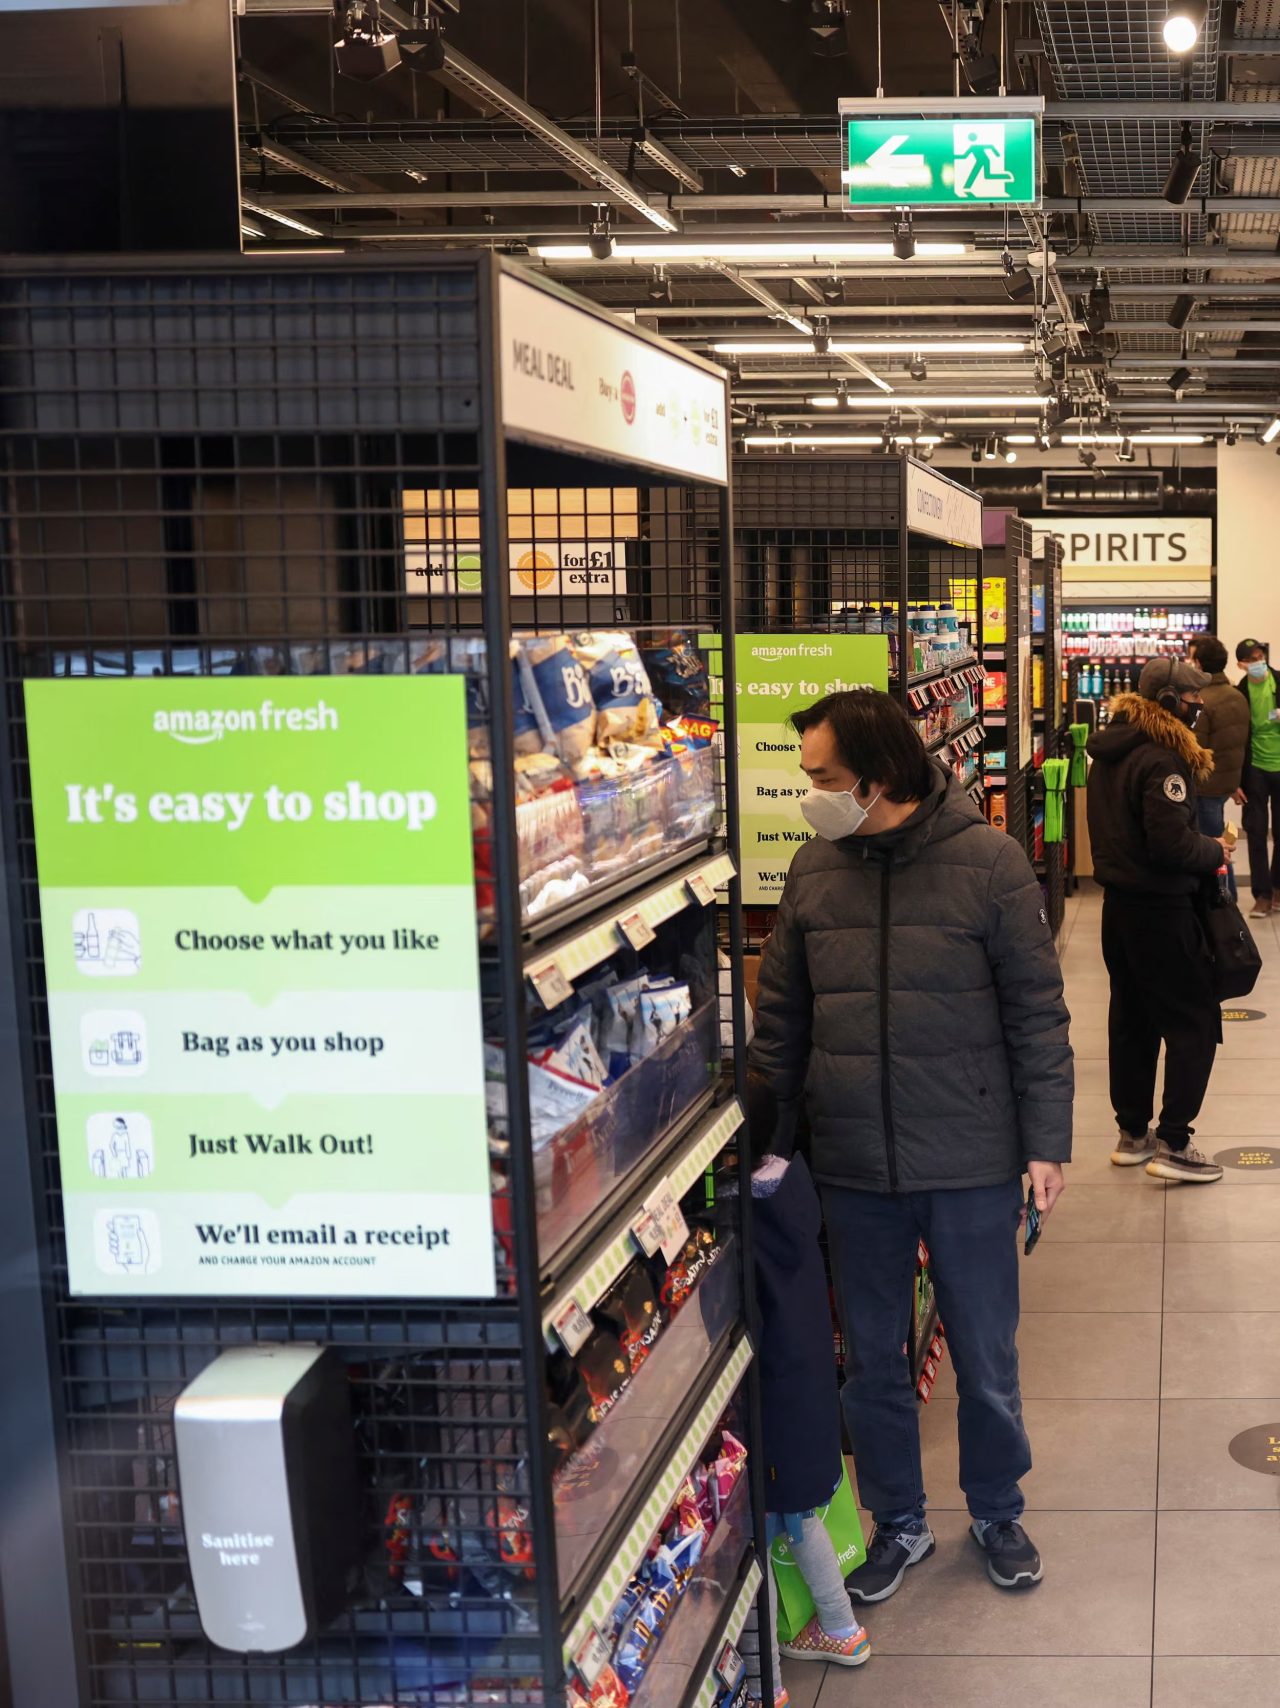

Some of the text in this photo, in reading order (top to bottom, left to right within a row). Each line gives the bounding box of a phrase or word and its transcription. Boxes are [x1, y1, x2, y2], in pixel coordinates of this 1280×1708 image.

[512, 338, 575, 391] MEAL DEAL
[598, 377, 612, 403] Buy
[1052, 532, 1187, 562] SPIRITS
[415, 563, 444, 577] add
[563, 551, 613, 570] for £1
[569, 572, 610, 584] extra
[751, 643, 833, 664] amazon fresh
[747, 681, 794, 699] easy
[799, 680, 821, 696] to
[153, 700, 339, 743] amazon fresh
[755, 742, 796, 752] Choose
[756, 786, 809, 799] Bag as yo
[66, 780, 438, 832] It's easy to shop
[757, 831, 812, 843] Just Walk
[758, 872, 787, 882] We'll
[174, 928, 440, 956] Choose what you like
[181, 1030, 385, 1058] Bag as you shop
[188, 1133, 374, 1159] Just Walk Out!
[195, 1223, 451, 1251] We'll email a receipt
[198, 1255, 377, 1266] AND CHARGE YOUR AMAZON ACCOUNT
[202, 1532, 274, 1550] Sanitise
[219, 1551, 260, 1567] here
